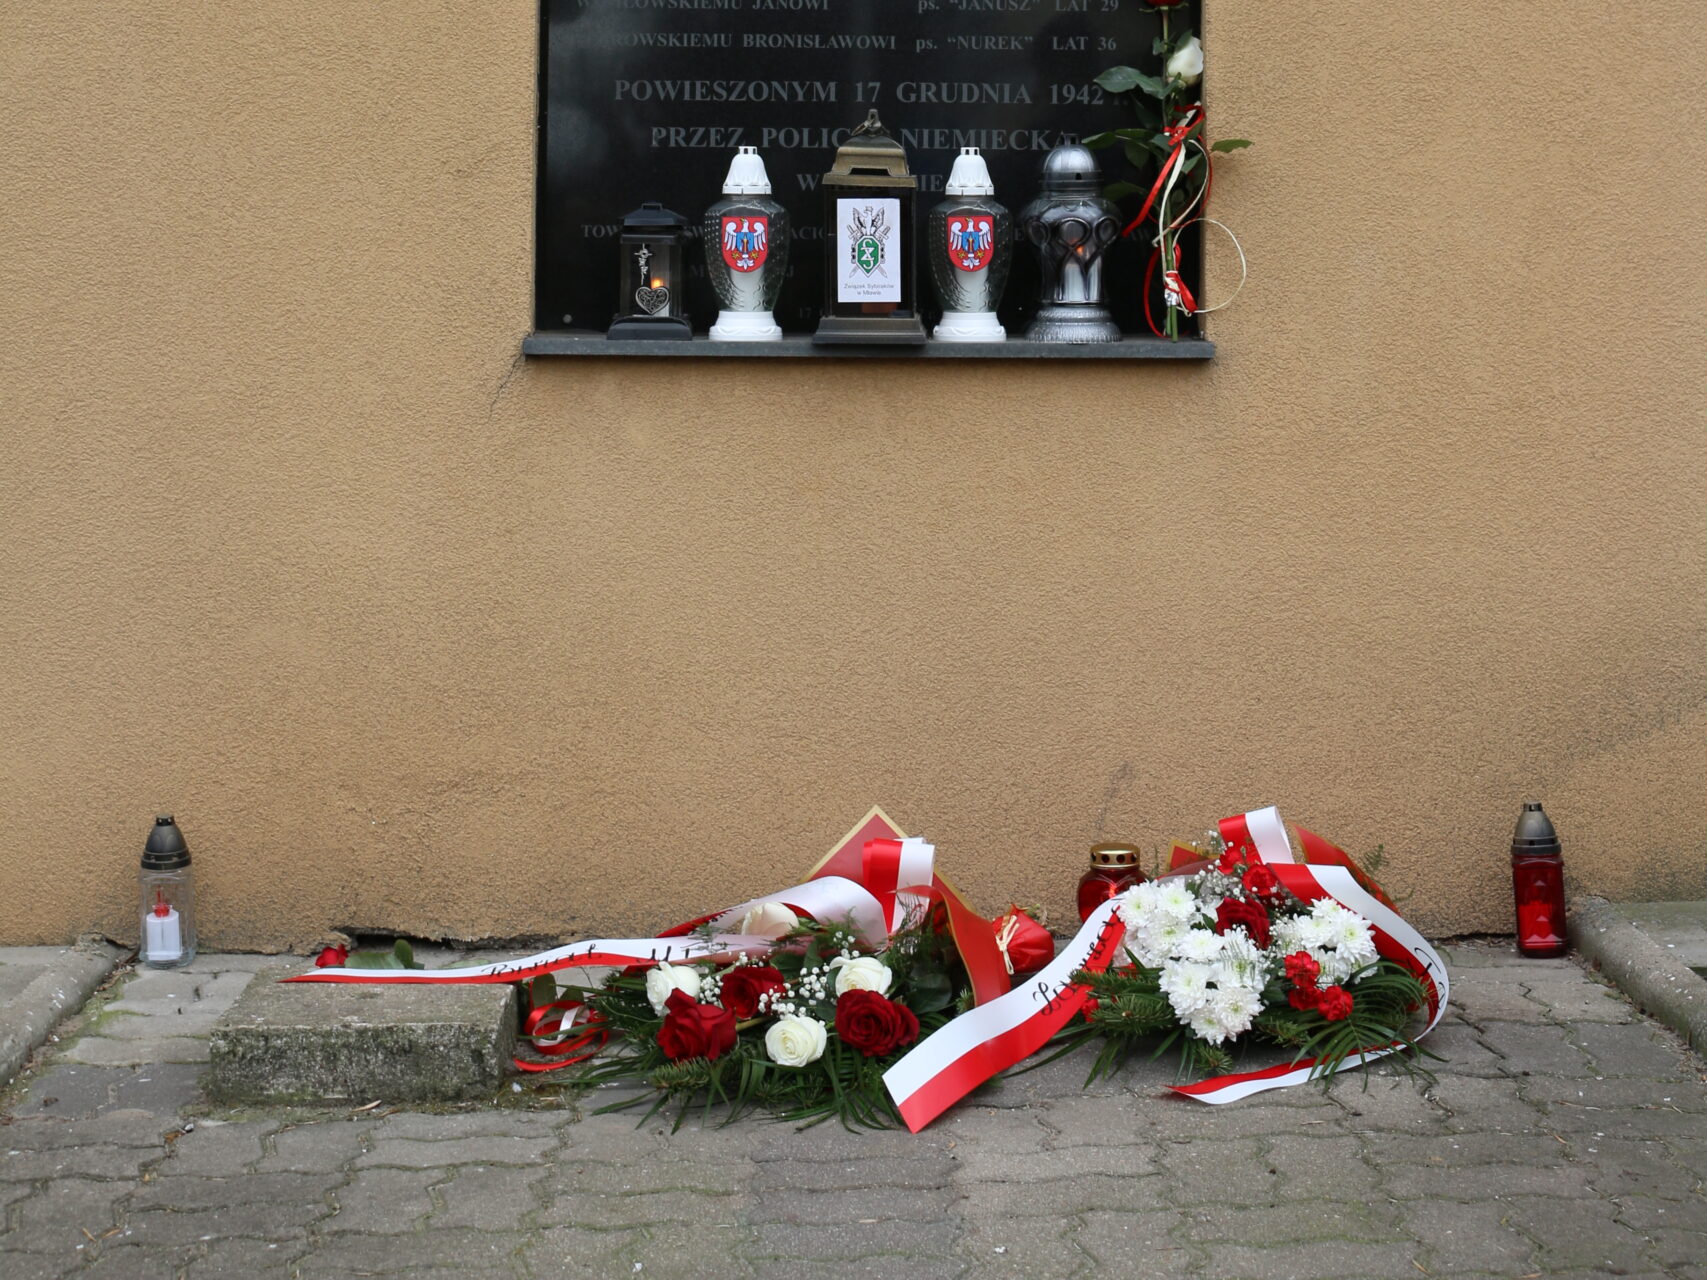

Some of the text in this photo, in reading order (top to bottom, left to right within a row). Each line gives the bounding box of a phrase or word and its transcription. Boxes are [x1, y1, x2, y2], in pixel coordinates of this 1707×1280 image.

[742, 33, 898, 51] BRONISŁAWOWI
[915, 36, 938, 53] ps.
[1051, 36, 1090, 52] LAT
[1096, 36, 1118, 52] 36
[614, 79, 838, 103] POWIESZONYM
[855, 81, 882, 104] 17
[895, 81, 1033, 105] GRUDNIA
[1049, 83, 1105, 106] 1942
[651, 126, 747, 149] PRZEZ
